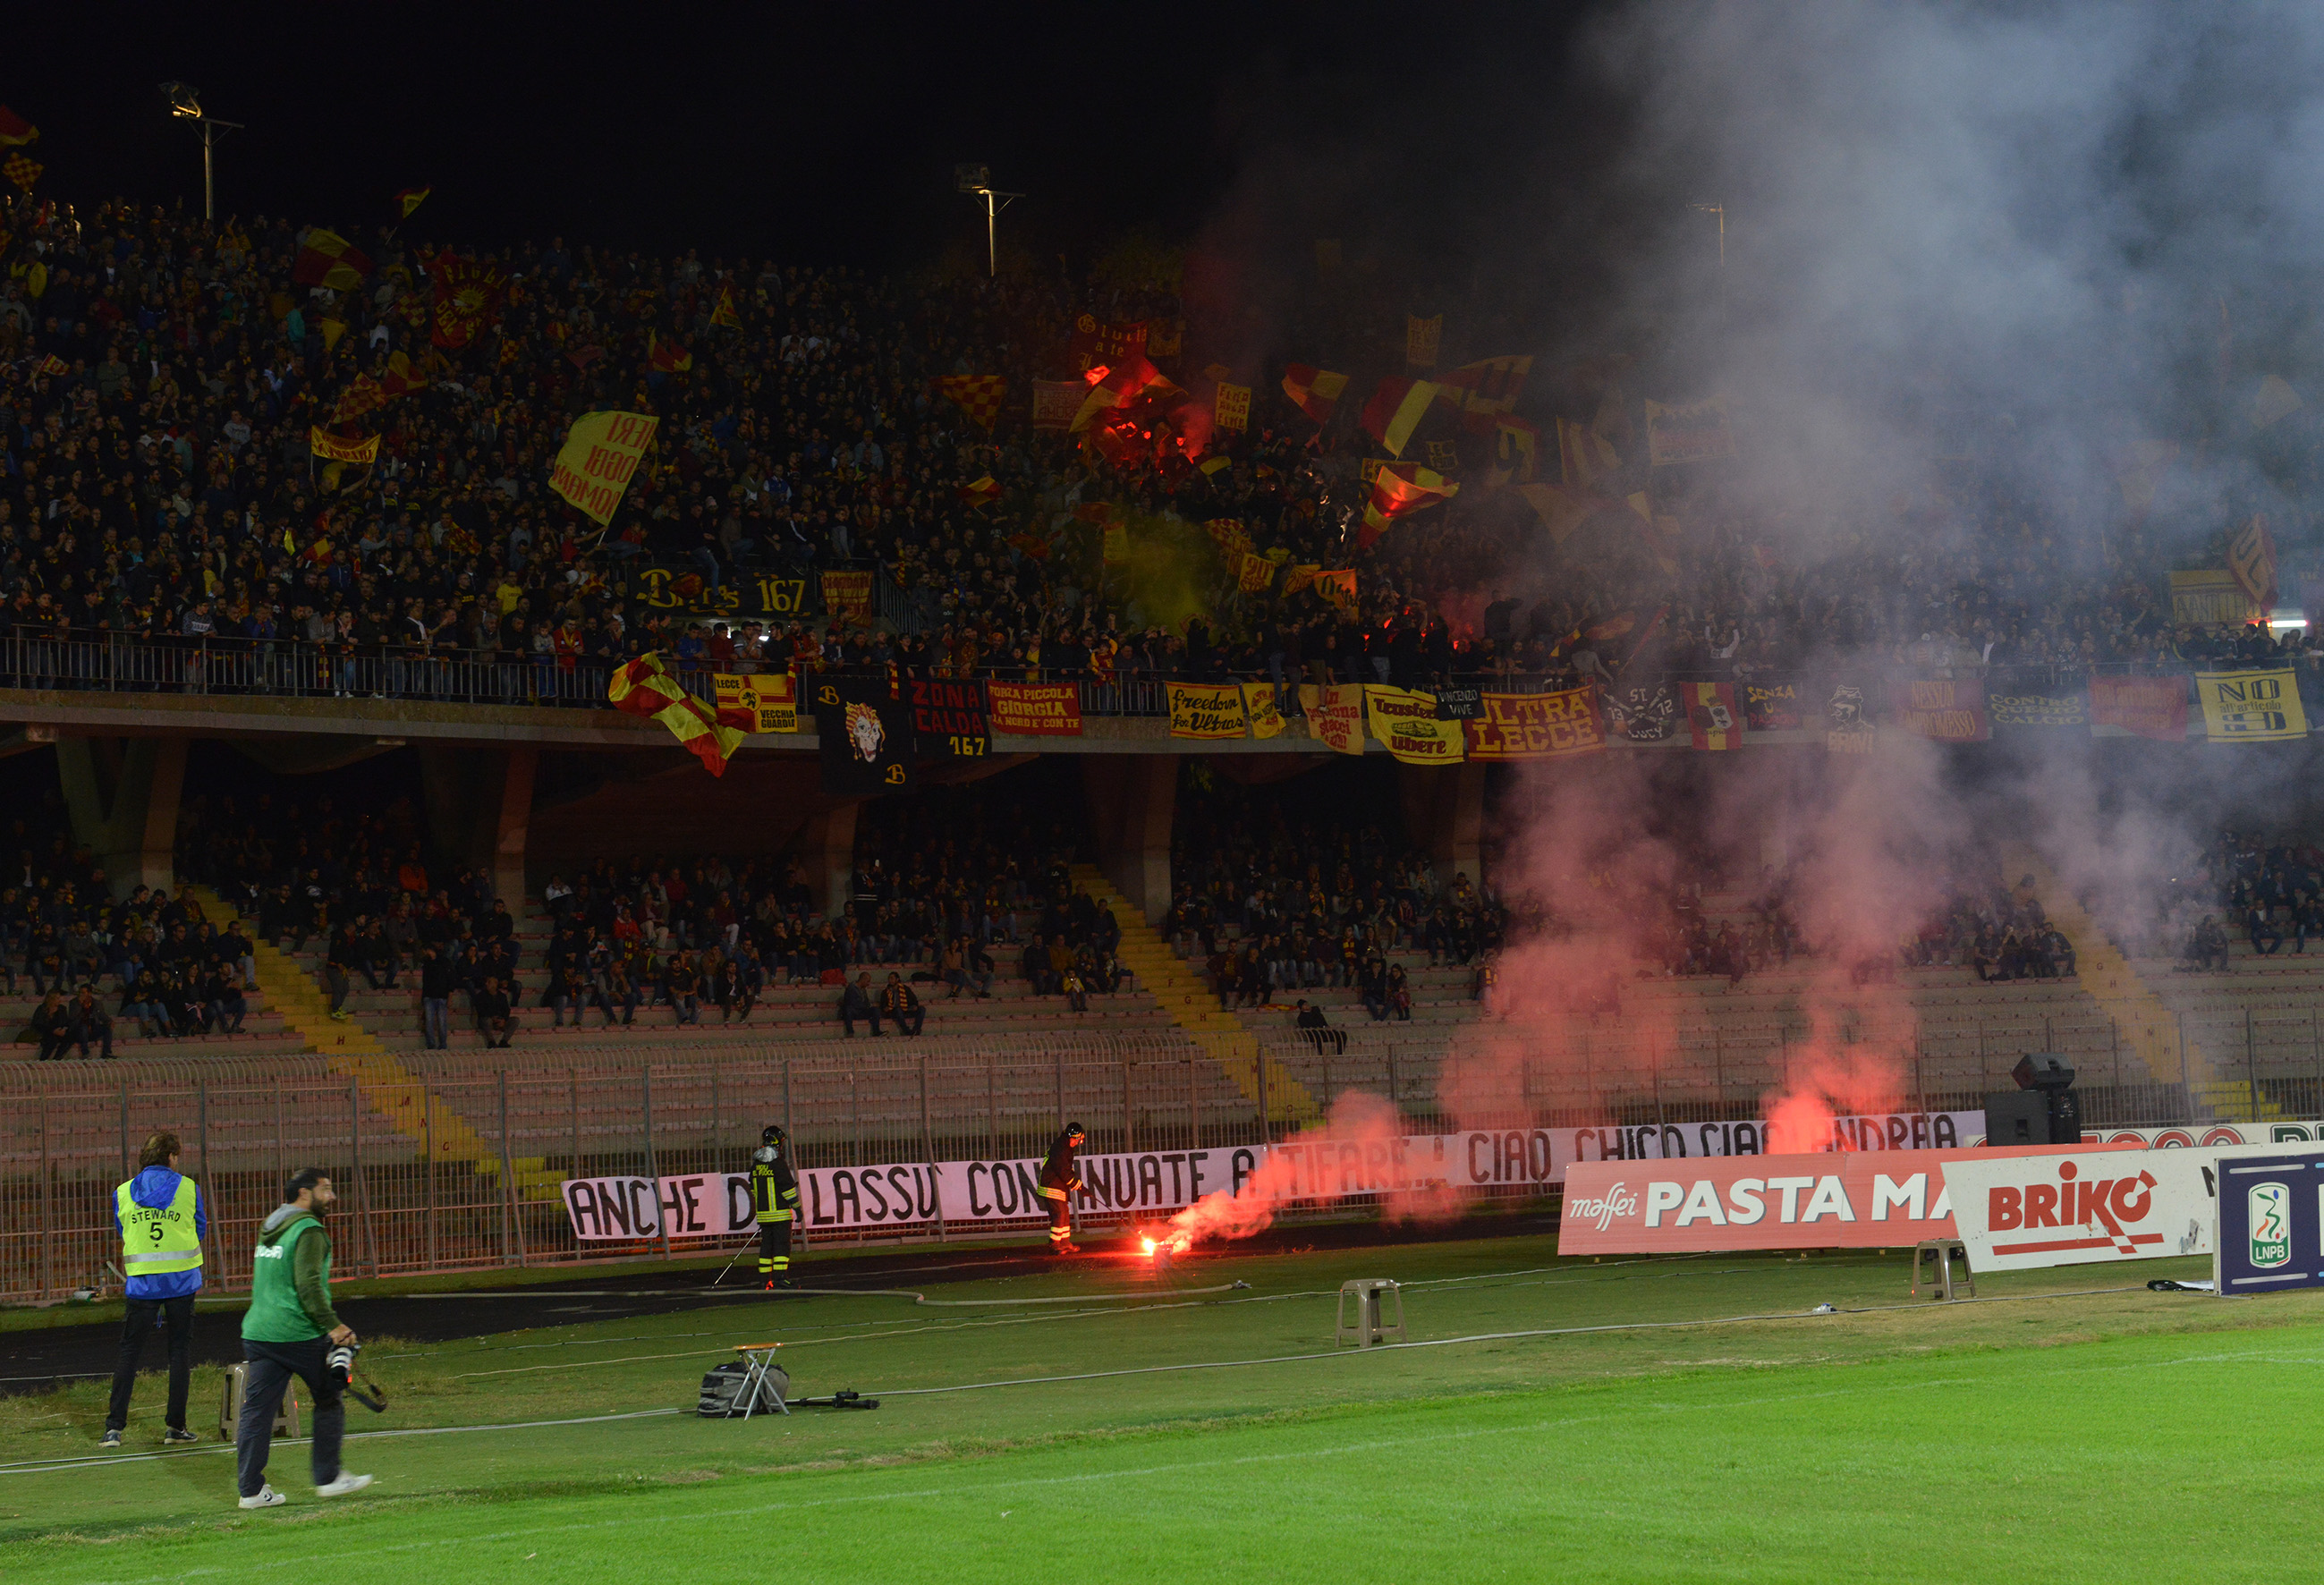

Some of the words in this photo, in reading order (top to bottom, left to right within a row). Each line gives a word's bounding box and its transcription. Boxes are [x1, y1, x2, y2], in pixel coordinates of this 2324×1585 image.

[756, 579, 806, 613] 167
[717, 680, 740, 690] LECCE
[989, 685, 1022, 699] FORZA
[1023, 688, 1075, 700] PICCOLA
[2218, 678, 2281, 703] NO
[910, 680, 980, 709] ZONA
[1438, 689, 1479, 702] VINCENZO
[1746, 684, 1796, 703] SENZA
[1990, 693, 2080, 707] CONTRO
[760, 709, 795, 719] VECCHIA
[997, 699, 1069, 716] GIORGIA
[1449, 704, 1473, 716] VIVE
[1991, 703, 2082, 715] QUESTO
[2219, 700, 2282, 713] all'articolo
[914, 708, 984, 734] CALDA
[1005, 716, 1030, 728] NORD
[1043, 718, 1064, 728] CON
[1065, 718, 1080, 728] TE
[1172, 714, 1189, 729] for
[1191, 712, 1244, 732] Ultras
[1993, 715, 2084, 726] CALCIO
[1472, 717, 1599, 752] LECCE
[948, 736, 986, 756] 167
[1200, 1013, 1207, 1021] H
[336, 1036, 345, 1045] H
[567, 1178, 705, 1236] ANCHE
[967, 1152, 1209, 1216] CONINUATE
[1468, 1131, 1552, 1183] CIAO
[1574, 1123, 1686, 1162] CHICO
[1569, 1182, 1639, 1232] maffei
[1644, 1175, 1857, 1228] PASTA
[131, 1208, 182, 1224] STEWARD
[149, 1222, 164, 1241] 5
[2255, 1244, 2286, 1260] LNPB
